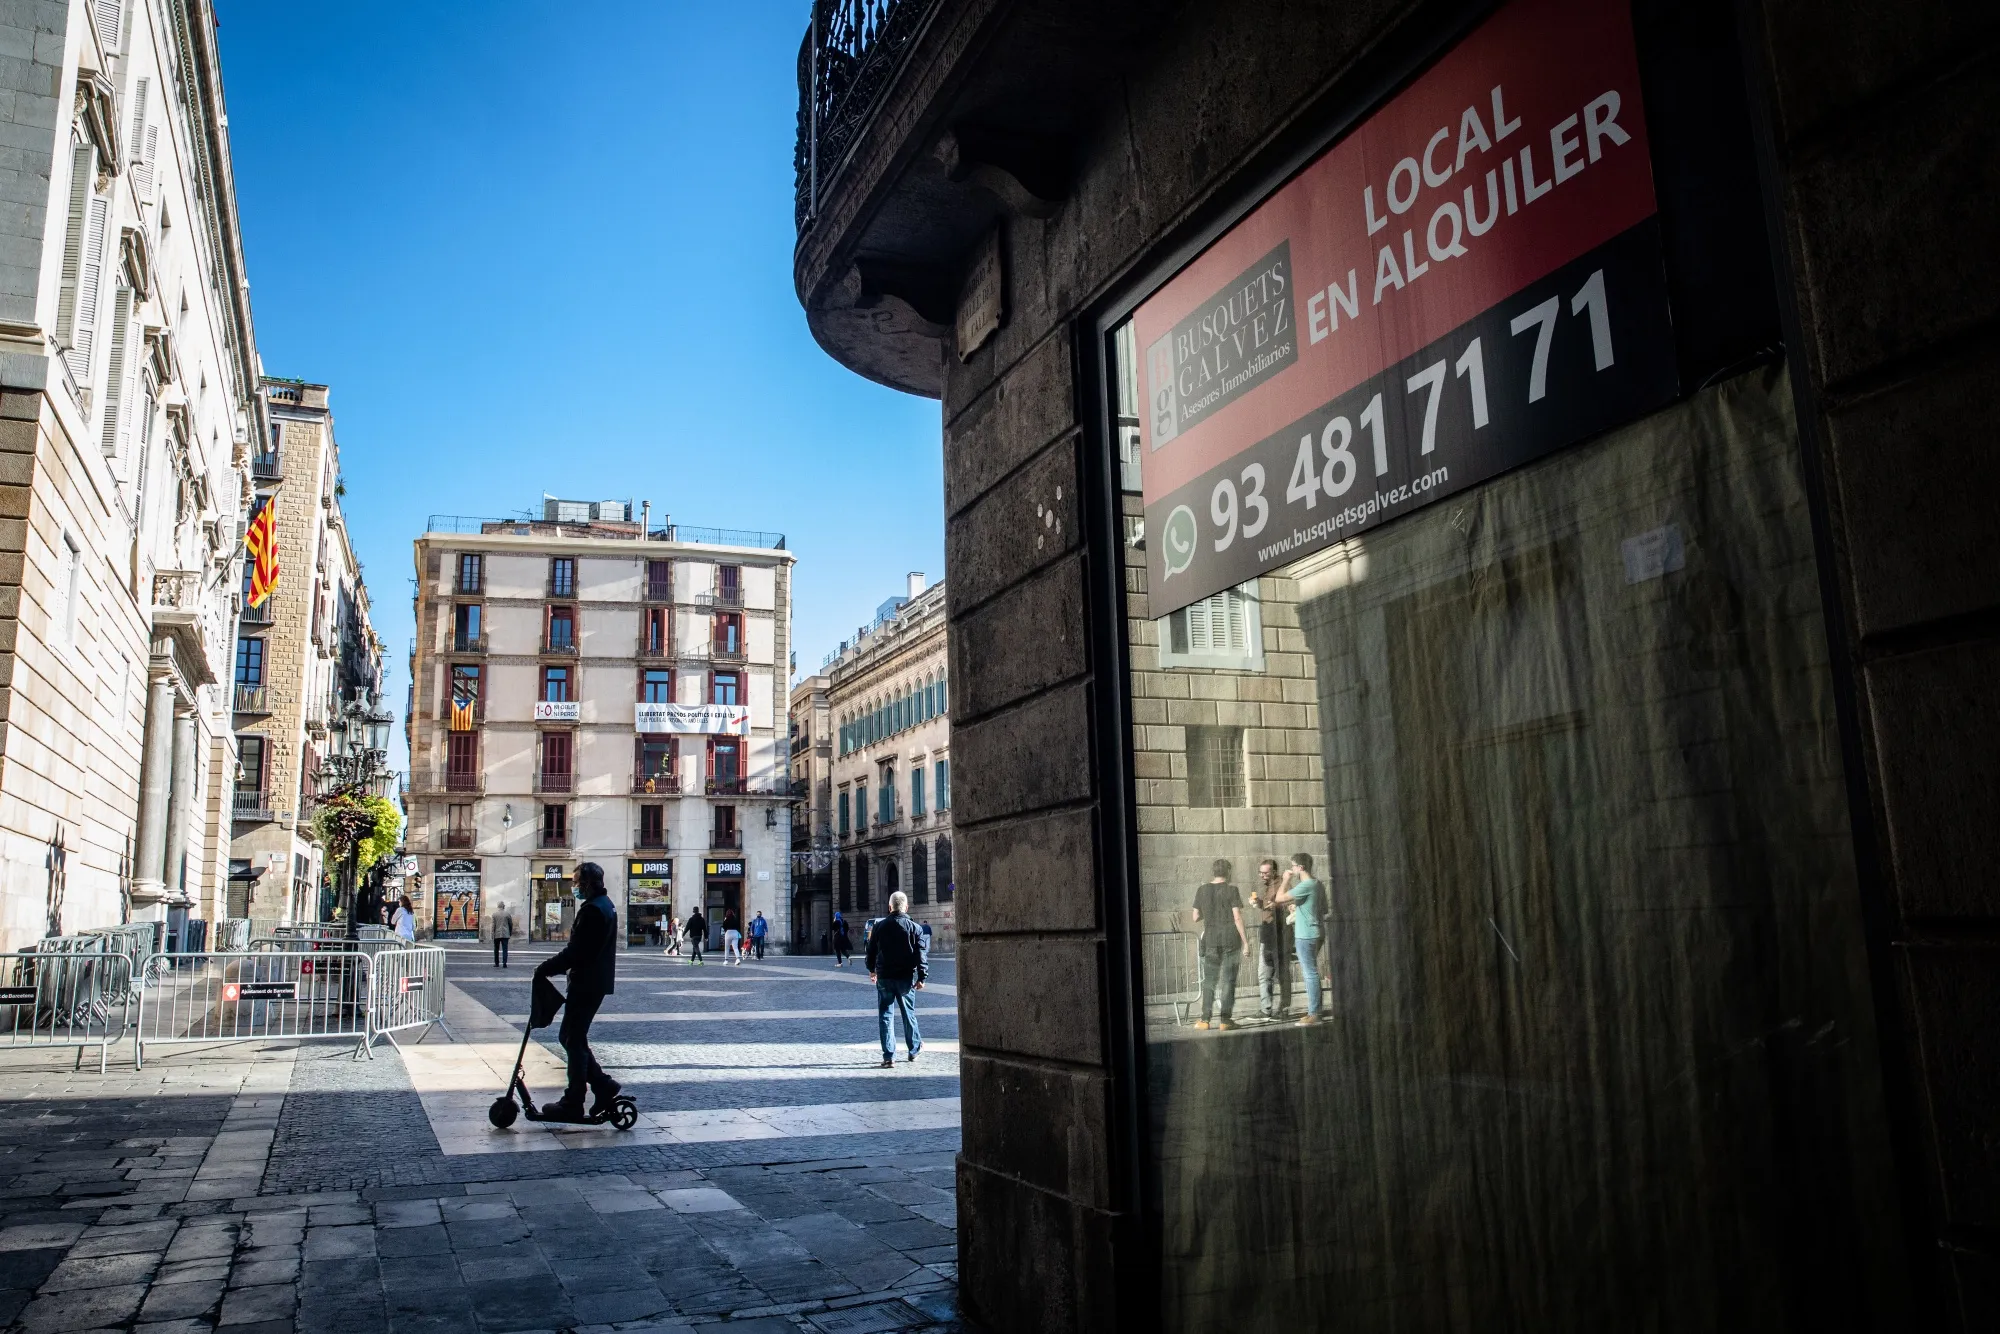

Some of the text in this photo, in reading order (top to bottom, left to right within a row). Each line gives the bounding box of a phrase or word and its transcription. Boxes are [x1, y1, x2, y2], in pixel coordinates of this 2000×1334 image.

[1363, 84, 1522, 237] LOCAL
[1307, 89, 1632, 347] EN ALQUILER
[1176, 261, 1286, 366] BUSQUETS
[1179, 297, 1289, 398] GALVEZ
[1155, 384, 1173, 438] g
[1180, 341, 1291, 423] Asesores Inmobiliarios
[1210, 267, 1615, 552] 93 481 71 71
[1257, 465, 1449, 563] www.busquetsgalvez.com
[441, 859, 475, 871] BARCELONA
[644, 863, 669, 873] pans
[718, 863, 741, 874] pans
